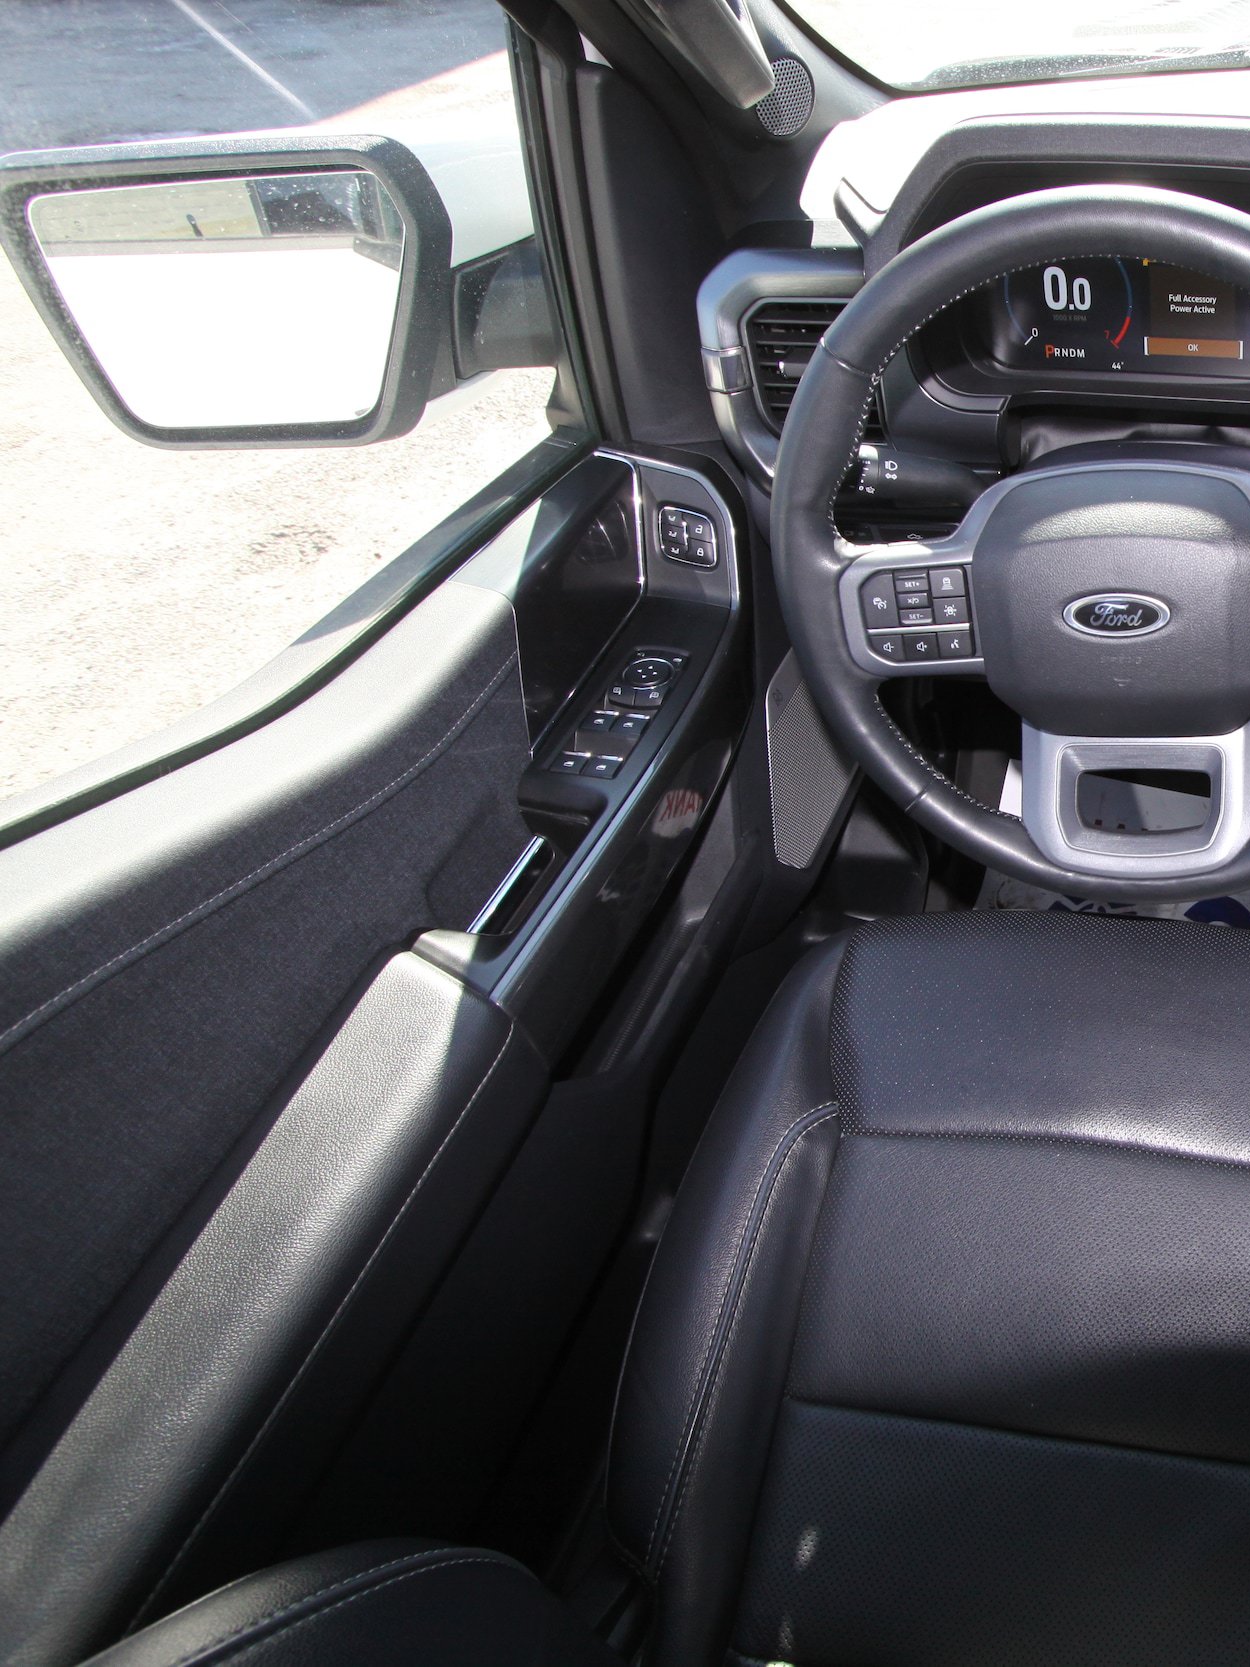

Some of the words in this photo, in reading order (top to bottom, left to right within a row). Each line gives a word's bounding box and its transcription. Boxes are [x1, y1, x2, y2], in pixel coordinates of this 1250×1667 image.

[1043, 266, 1092, 311] 0.0
[1168, 293, 1182, 302] Full
[1183, 295, 1217, 305] Accessory
[1170, 304, 1192, 313] Power
[1193, 305, 1216, 314] Active
[1032, 327, 1039, 337] 0
[1187, 343, 1199, 352] OK
[1090, 602, 1143, 627] Ford
